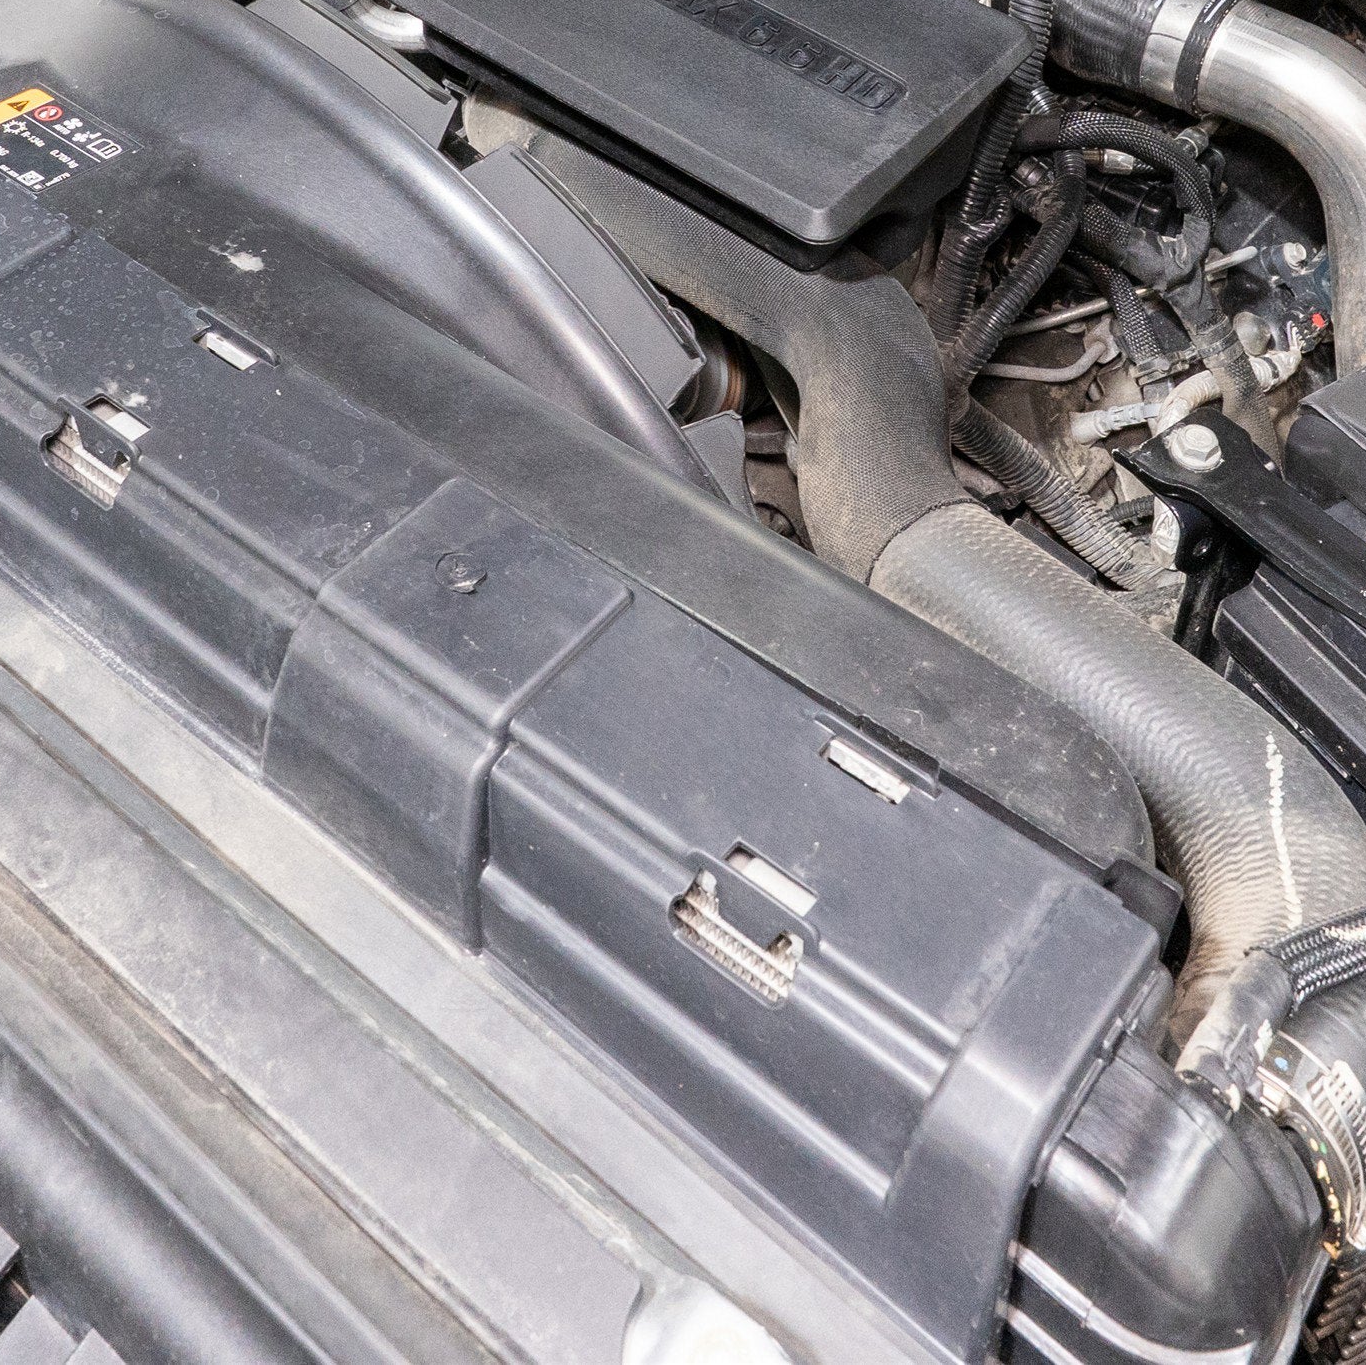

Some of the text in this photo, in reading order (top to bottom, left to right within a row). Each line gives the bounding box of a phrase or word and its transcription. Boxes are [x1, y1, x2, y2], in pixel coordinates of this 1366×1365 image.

[733, 15, 824, 71] 6.6
[815, 57, 901, 112] HD
[66, 160, 79, 170] kg
